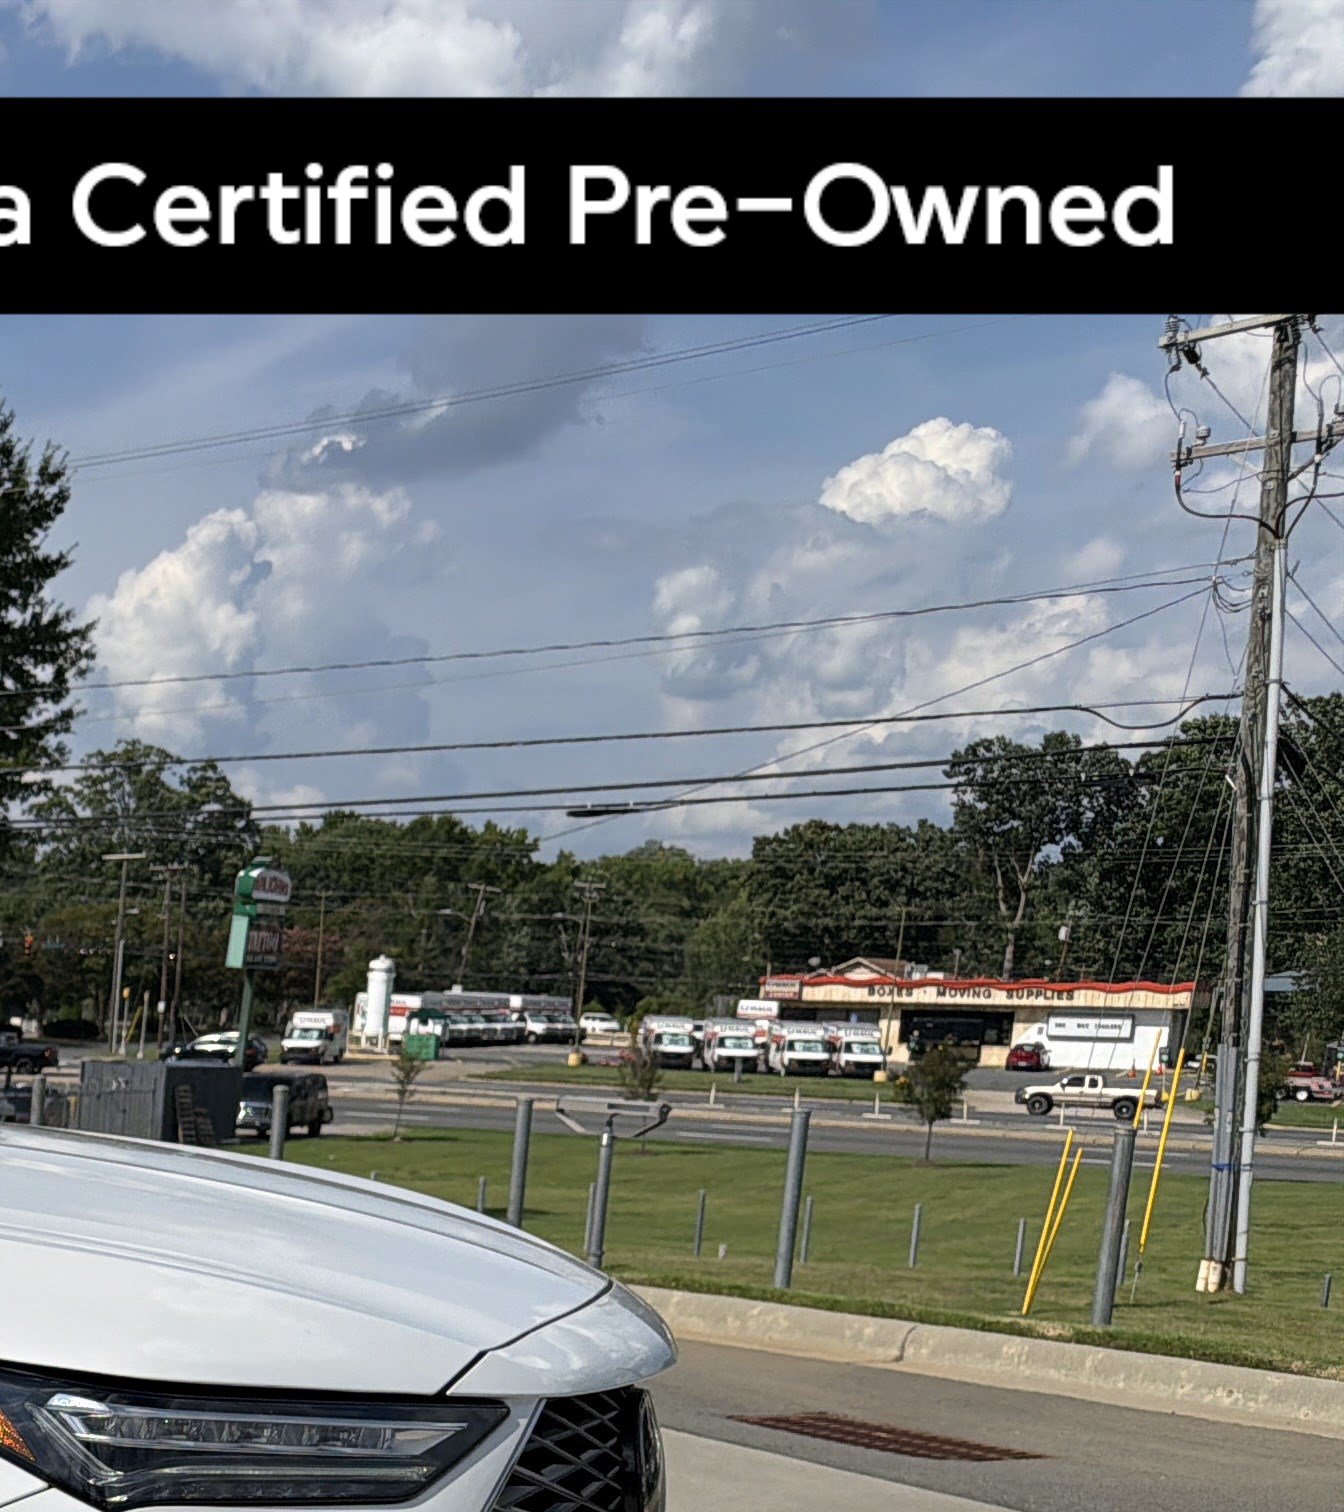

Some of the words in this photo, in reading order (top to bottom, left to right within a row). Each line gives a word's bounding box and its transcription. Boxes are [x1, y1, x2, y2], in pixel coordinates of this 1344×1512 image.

[868, 985, 913, 998] BOXES
[936, 987, 992, 999] MOVING
[1006, 988, 1075, 1001] SUPPLIES
